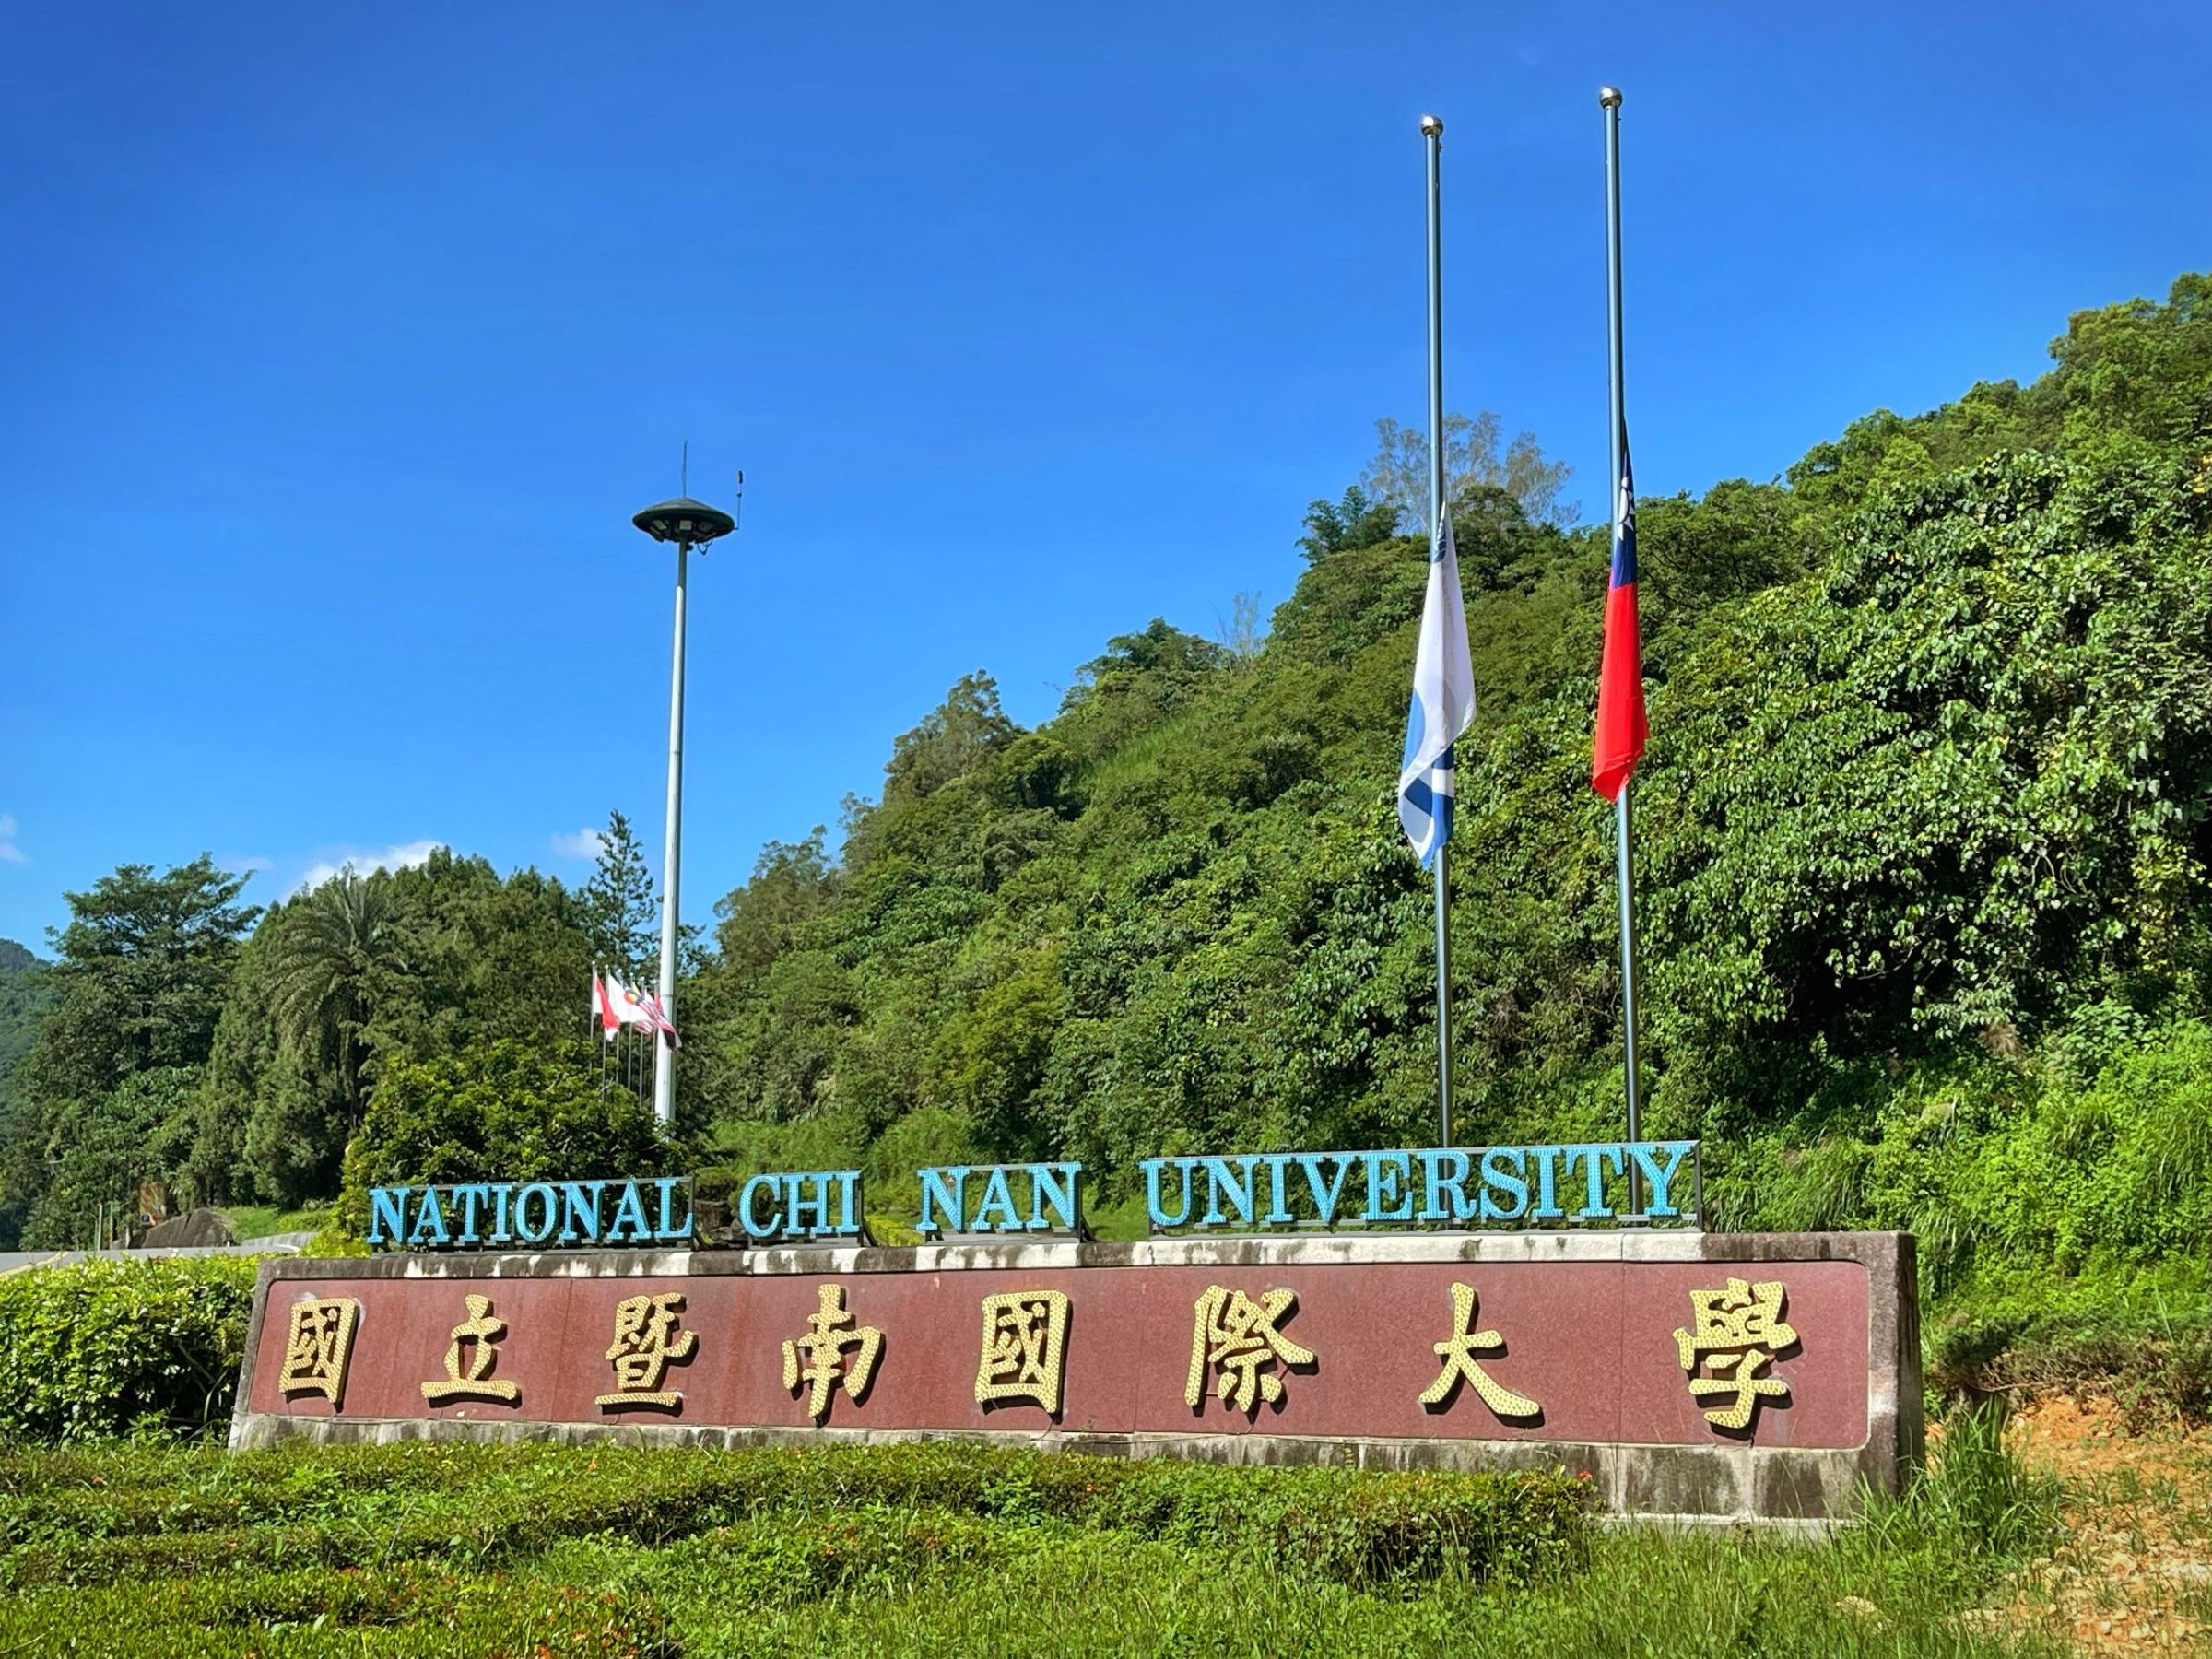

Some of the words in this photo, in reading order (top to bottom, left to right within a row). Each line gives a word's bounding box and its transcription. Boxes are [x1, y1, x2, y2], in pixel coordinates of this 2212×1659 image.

[369, 1179, 694, 1244] NATIONAL
[739, 1170, 861, 1238] CHI
[916, 1162, 1082, 1231] NAN
[1140, 1142, 1692, 1226] UNIVERSITY
[278, 1277, 1799, 1429] 國立暨南國際大學
